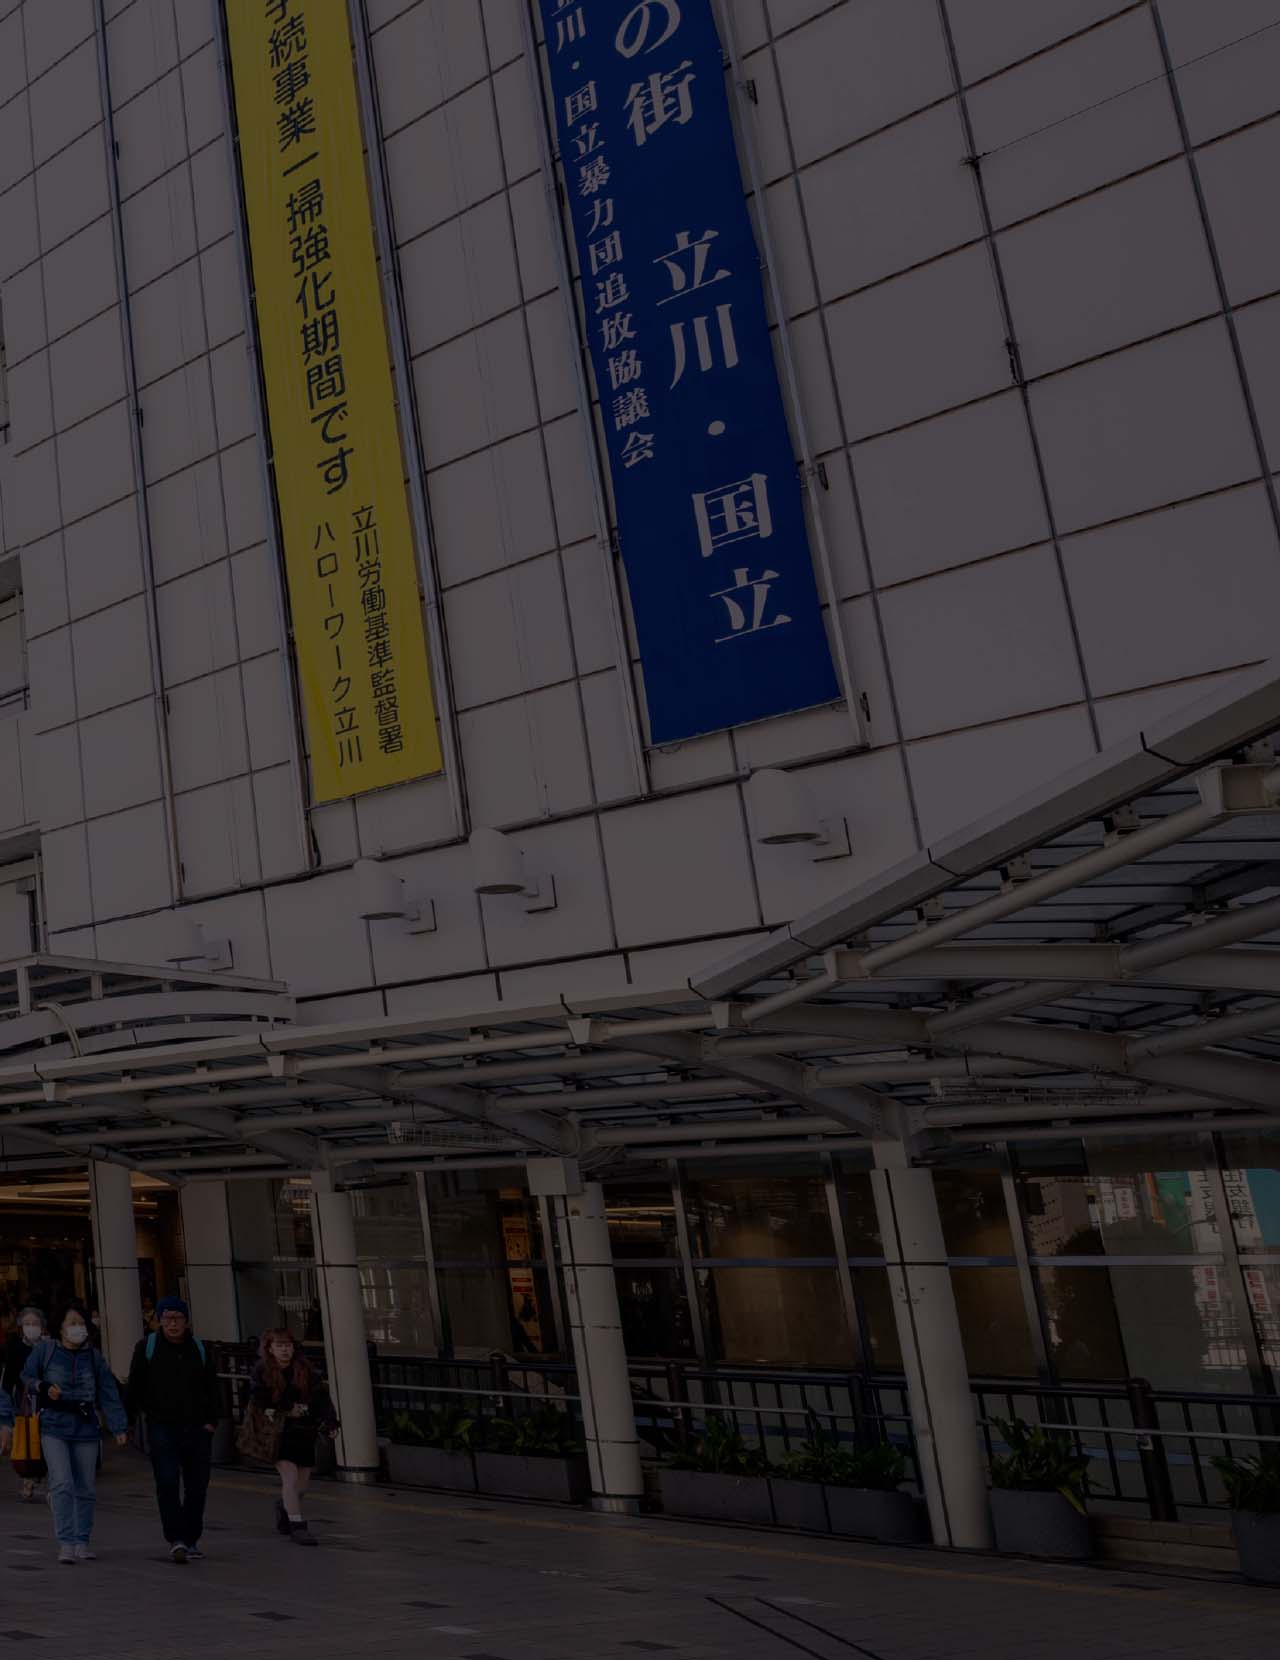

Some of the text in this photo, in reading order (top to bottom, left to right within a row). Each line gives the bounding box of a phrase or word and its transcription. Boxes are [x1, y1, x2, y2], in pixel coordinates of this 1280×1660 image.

[614, 0, 793, 644] の街 立川・国立
[313, 520, 364, 769] ハローワーク立川
[350, 504, 405, 755] 立川労働基準監督署
